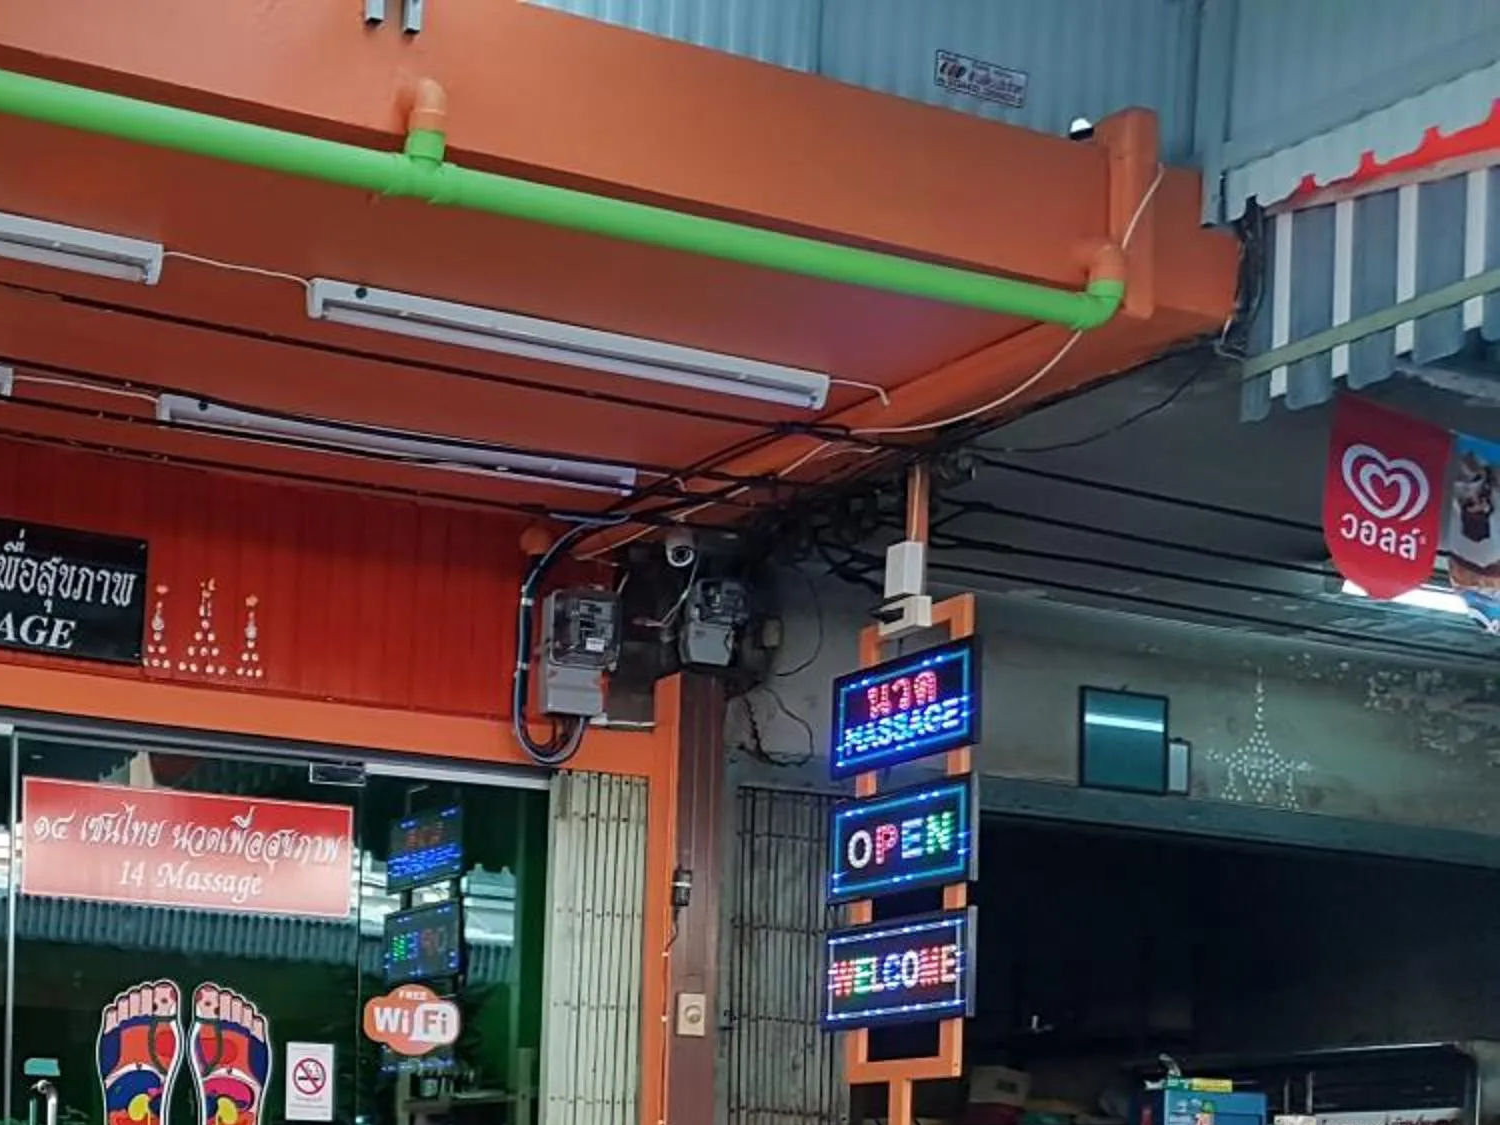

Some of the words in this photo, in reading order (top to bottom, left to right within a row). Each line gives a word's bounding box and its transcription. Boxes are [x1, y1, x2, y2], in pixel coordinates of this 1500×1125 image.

[847, 811, 954, 869] OPEN
[118, 860, 146, 888] 14
[156, 861, 263, 903] Massage
[833, 944, 959, 998] WELCOME
